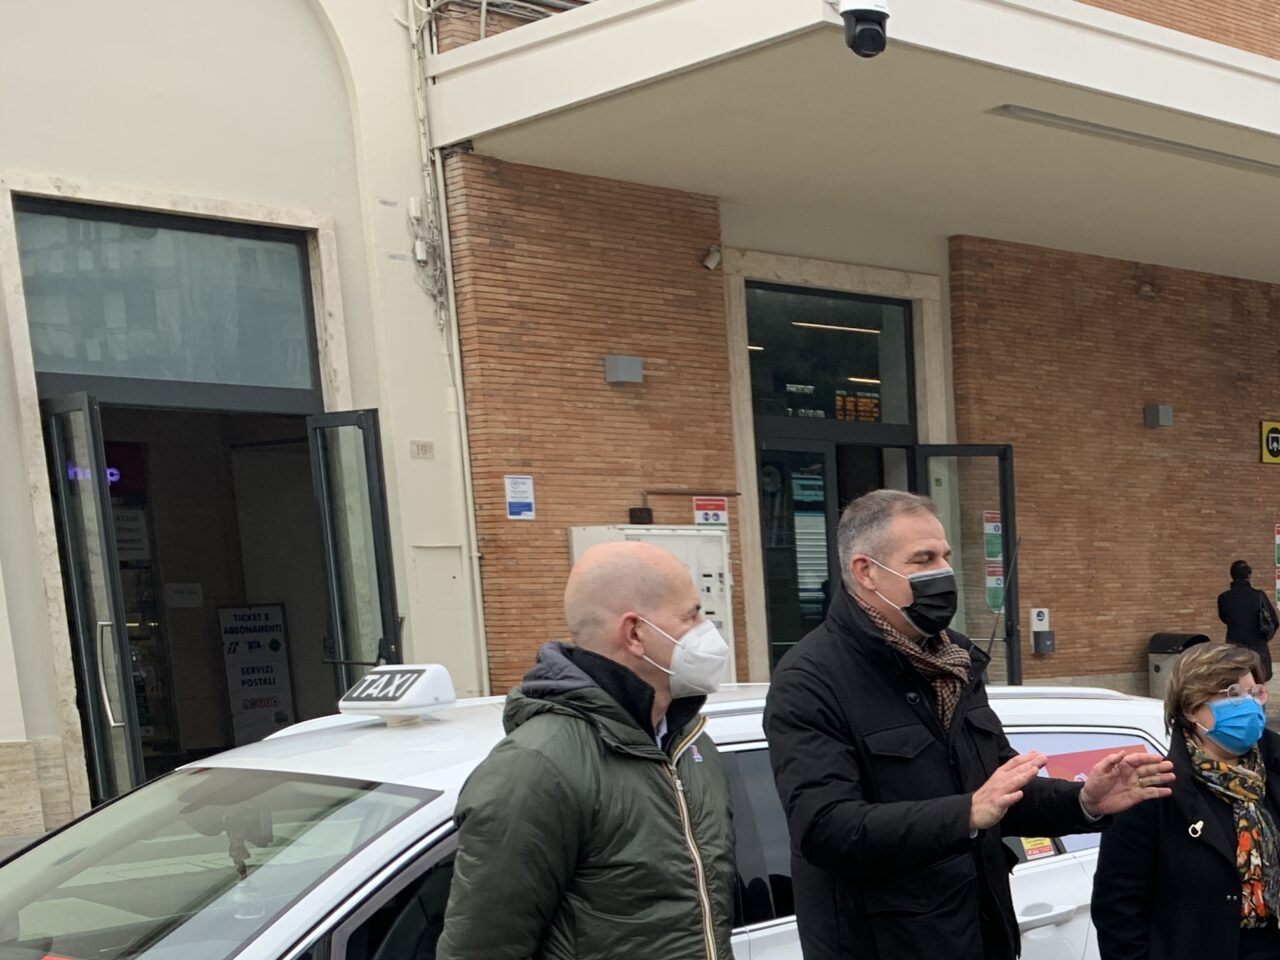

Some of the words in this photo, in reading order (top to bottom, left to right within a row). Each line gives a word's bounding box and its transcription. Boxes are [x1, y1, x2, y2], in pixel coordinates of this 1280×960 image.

[233, 613, 262, 622] TICKET
[224, 624, 282, 635] ABBONAMENTI
[241, 665, 273, 676] SERVIZI
[241, 677, 276, 688] POSTALI
[352, 673, 418, 698] TAXI
